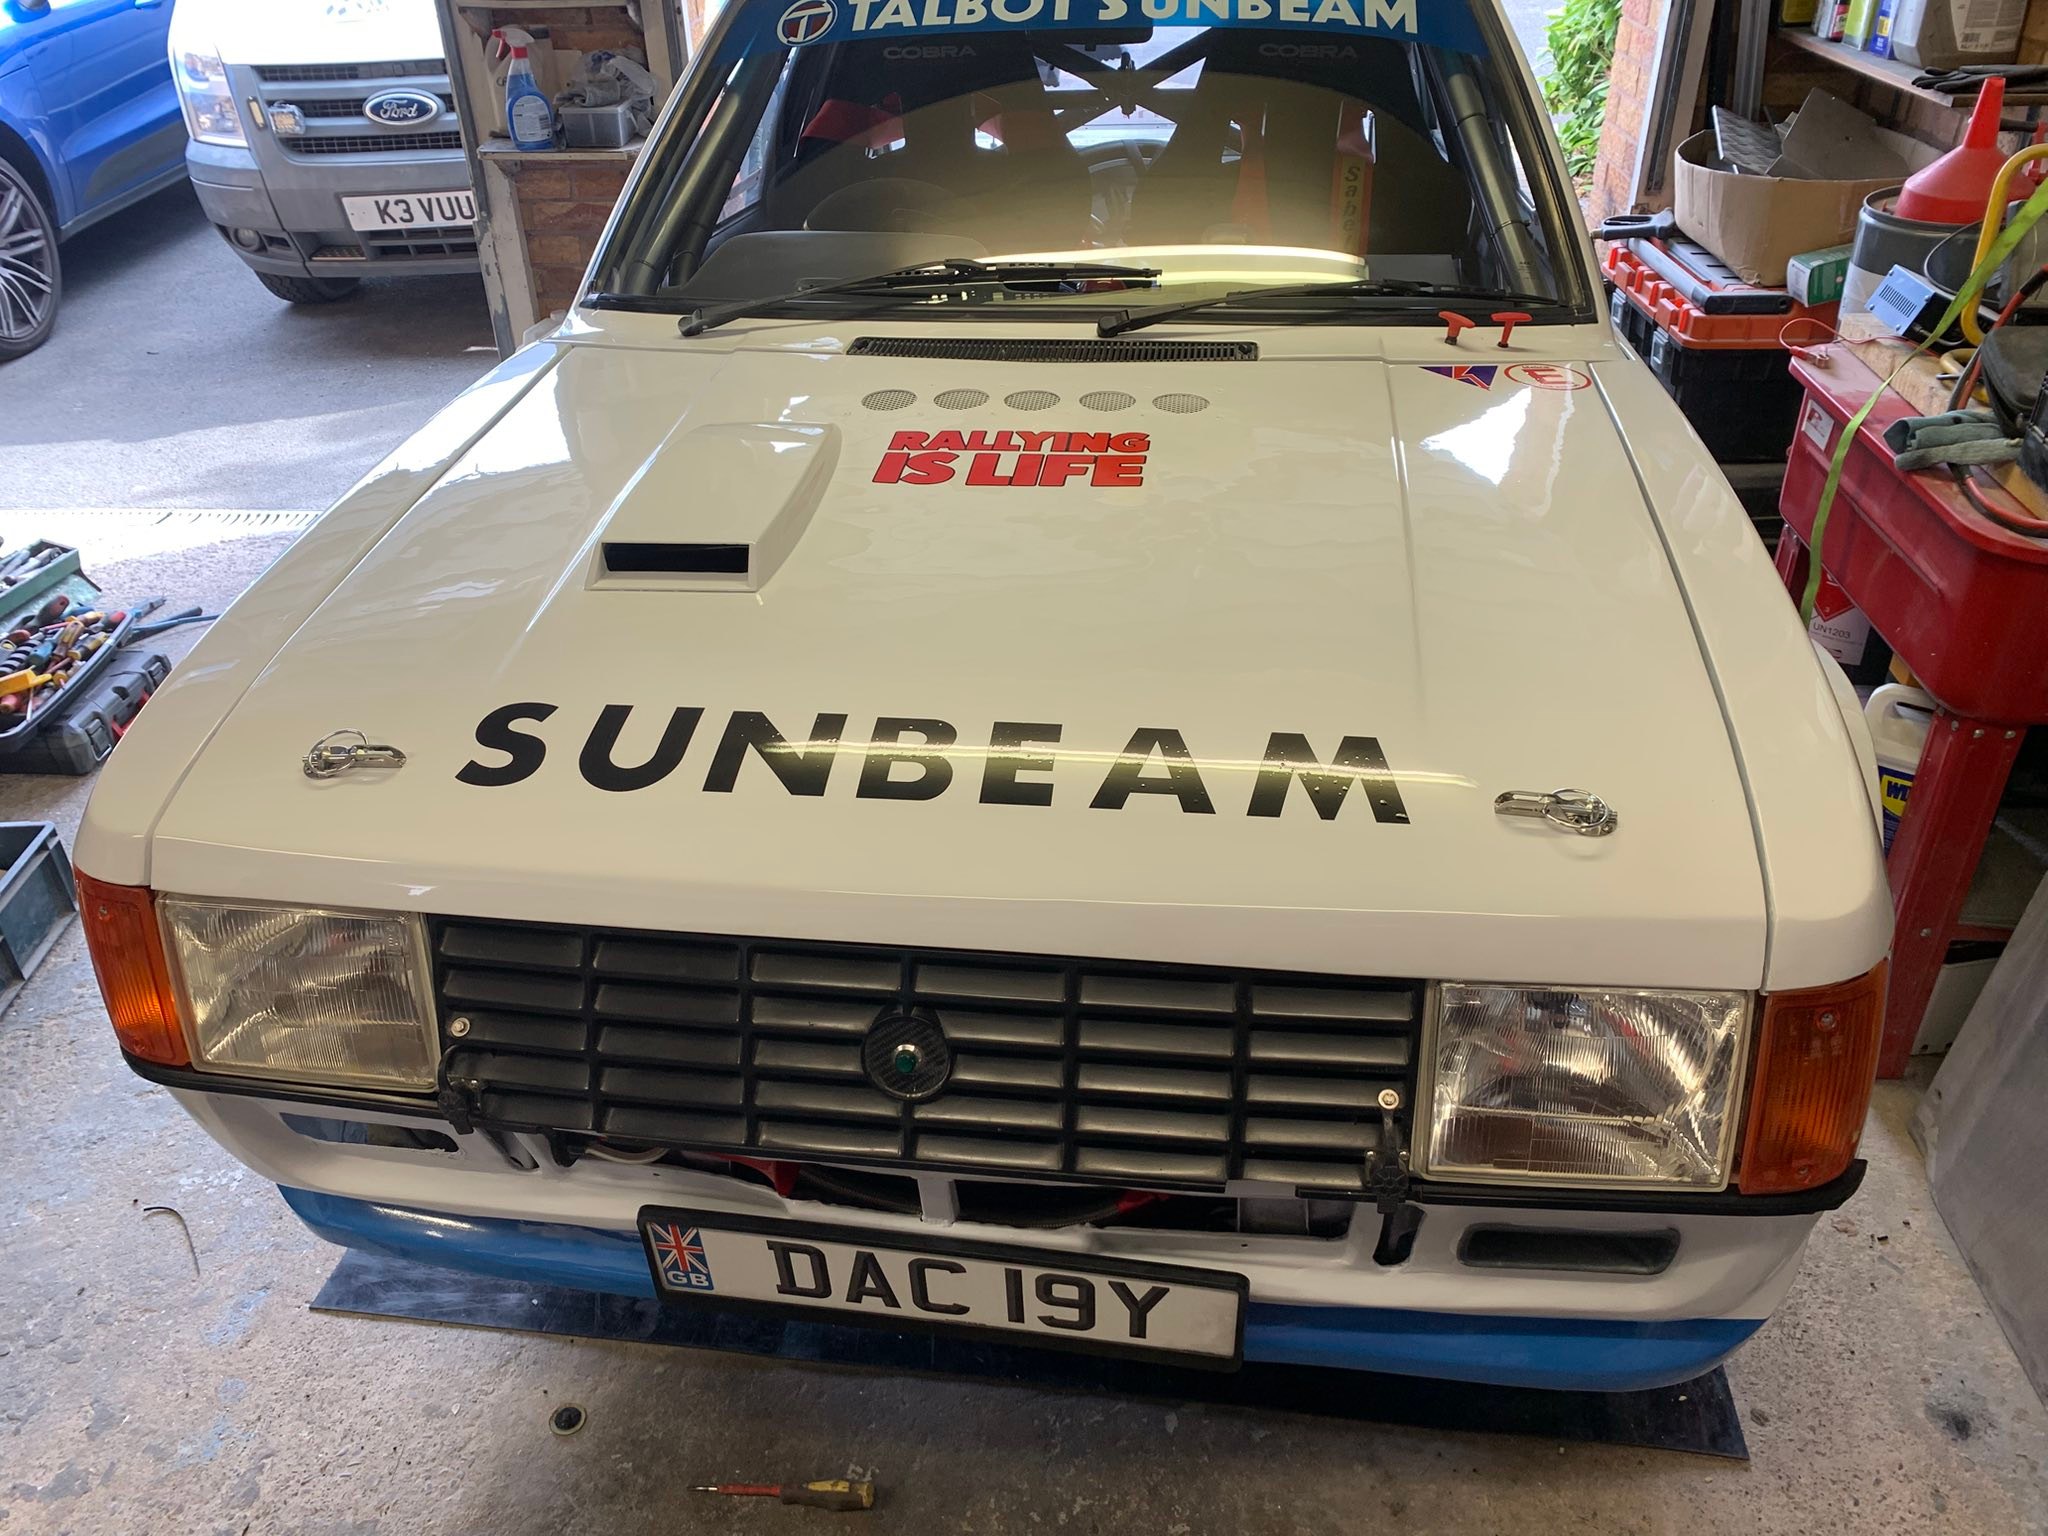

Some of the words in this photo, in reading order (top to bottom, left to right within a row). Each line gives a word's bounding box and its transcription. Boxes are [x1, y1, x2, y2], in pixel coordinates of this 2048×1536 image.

[851, 0, 1070, 31] TALBOT
[1098, 0, 1418, 34] SUNBEAM
[883, 45, 977, 60] COBRA
[1258, 42, 1358, 58] COBRA
[379, 99, 419, 119] Ford
[374, 198, 414, 224] K3
[416, 195, 476, 222] VUU
[887, 430, 1151, 453] RALLYING
[872, 451, 960, 485] IS
[965, 453, 1147, 487] LIFE
[1812, 621, 1851, 640] UN1203
[454, 701, 1412, 825] SUNBEAM
[665, 1269, 710, 1288] GB
[765, 1239, 971, 1316] DAC
[1004, 1267, 1171, 1339] 19Y
